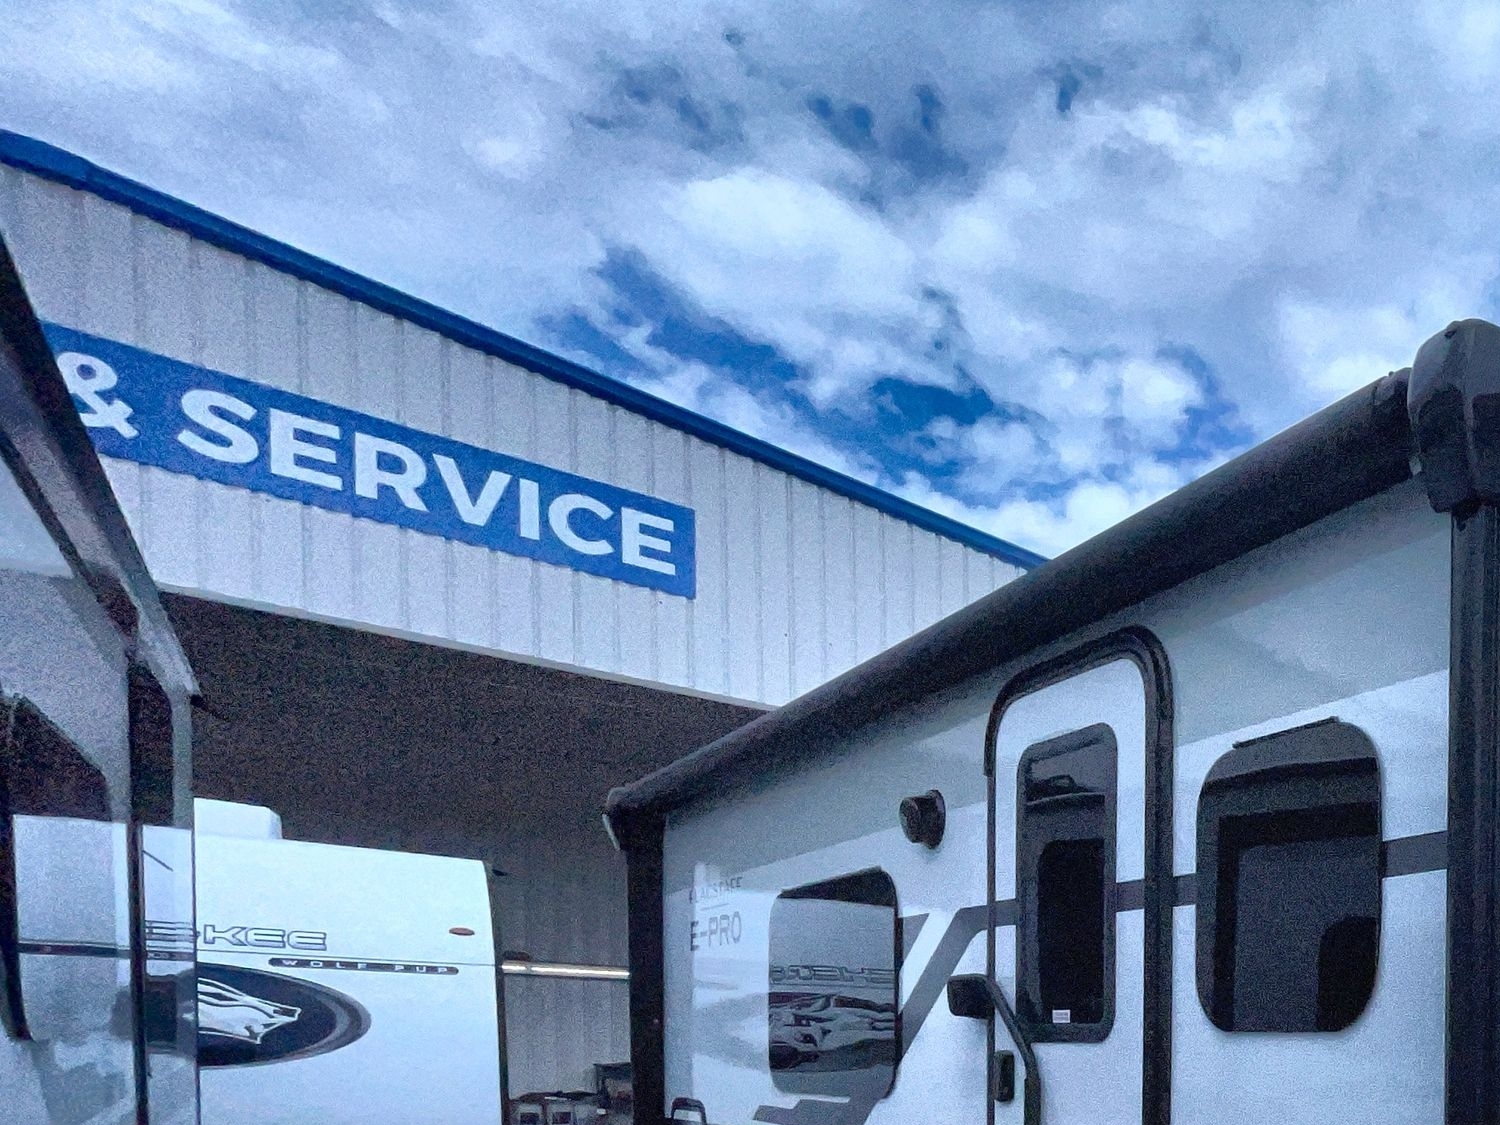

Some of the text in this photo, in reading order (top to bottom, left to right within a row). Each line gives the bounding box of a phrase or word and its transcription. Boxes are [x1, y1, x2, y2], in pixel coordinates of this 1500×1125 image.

[57, 352, 676, 576] & SERVICE
[199, 924, 327, 951] KEE
[690, 911, 742, 952] E-PRO
[281, 959, 448, 974] WOLF PUP
